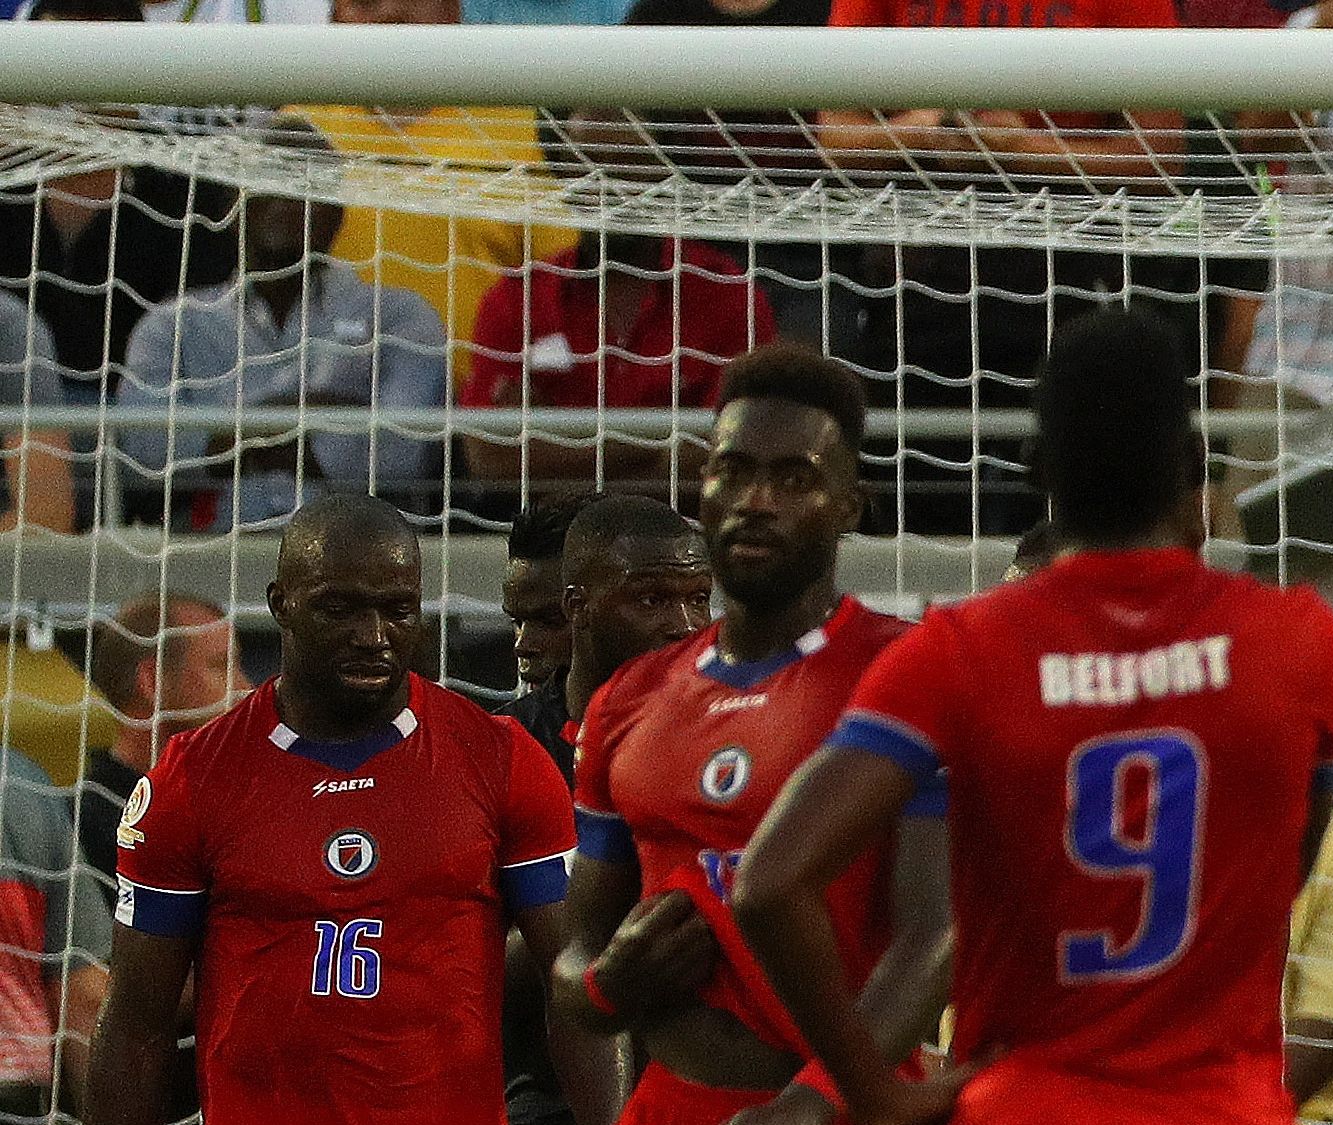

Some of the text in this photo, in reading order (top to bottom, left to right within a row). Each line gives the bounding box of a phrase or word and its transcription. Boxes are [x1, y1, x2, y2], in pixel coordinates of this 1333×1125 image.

[1038, 633, 1233, 707] BELFORT
[327, 777, 375, 793] SAETA
[1057, 724, 1210, 986] 9
[311, 918, 383, 998] 16
